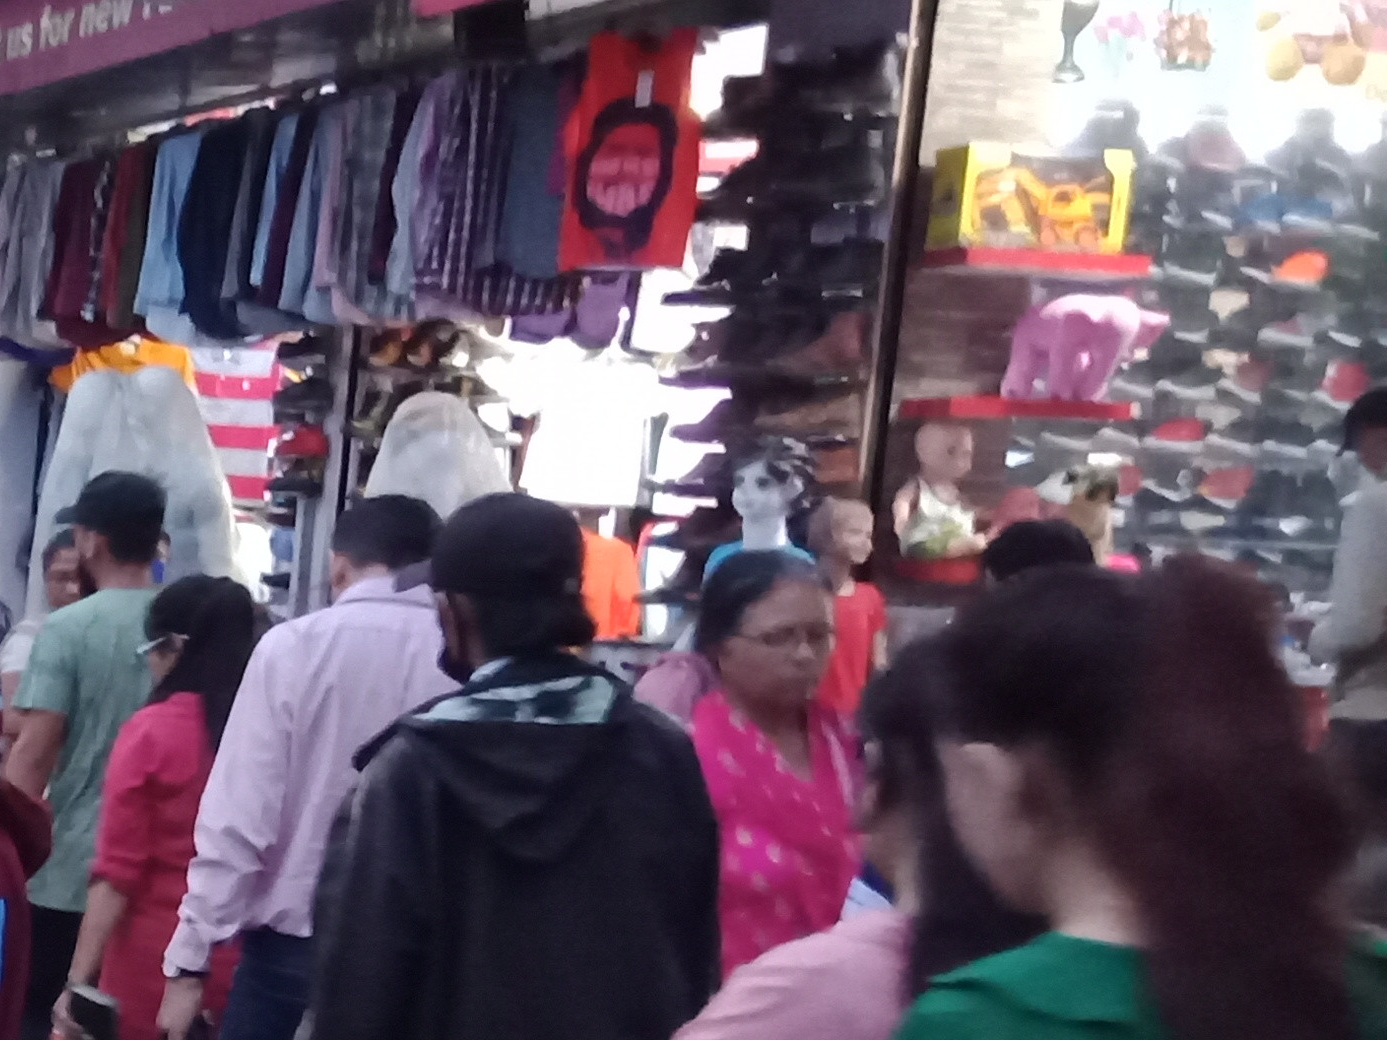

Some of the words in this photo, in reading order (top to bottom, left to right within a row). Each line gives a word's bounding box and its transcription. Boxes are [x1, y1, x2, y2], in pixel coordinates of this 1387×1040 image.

[6, 22, 33, 60] us
[39, 4, 76, 49] for
[79, 0, 132, 38] new
